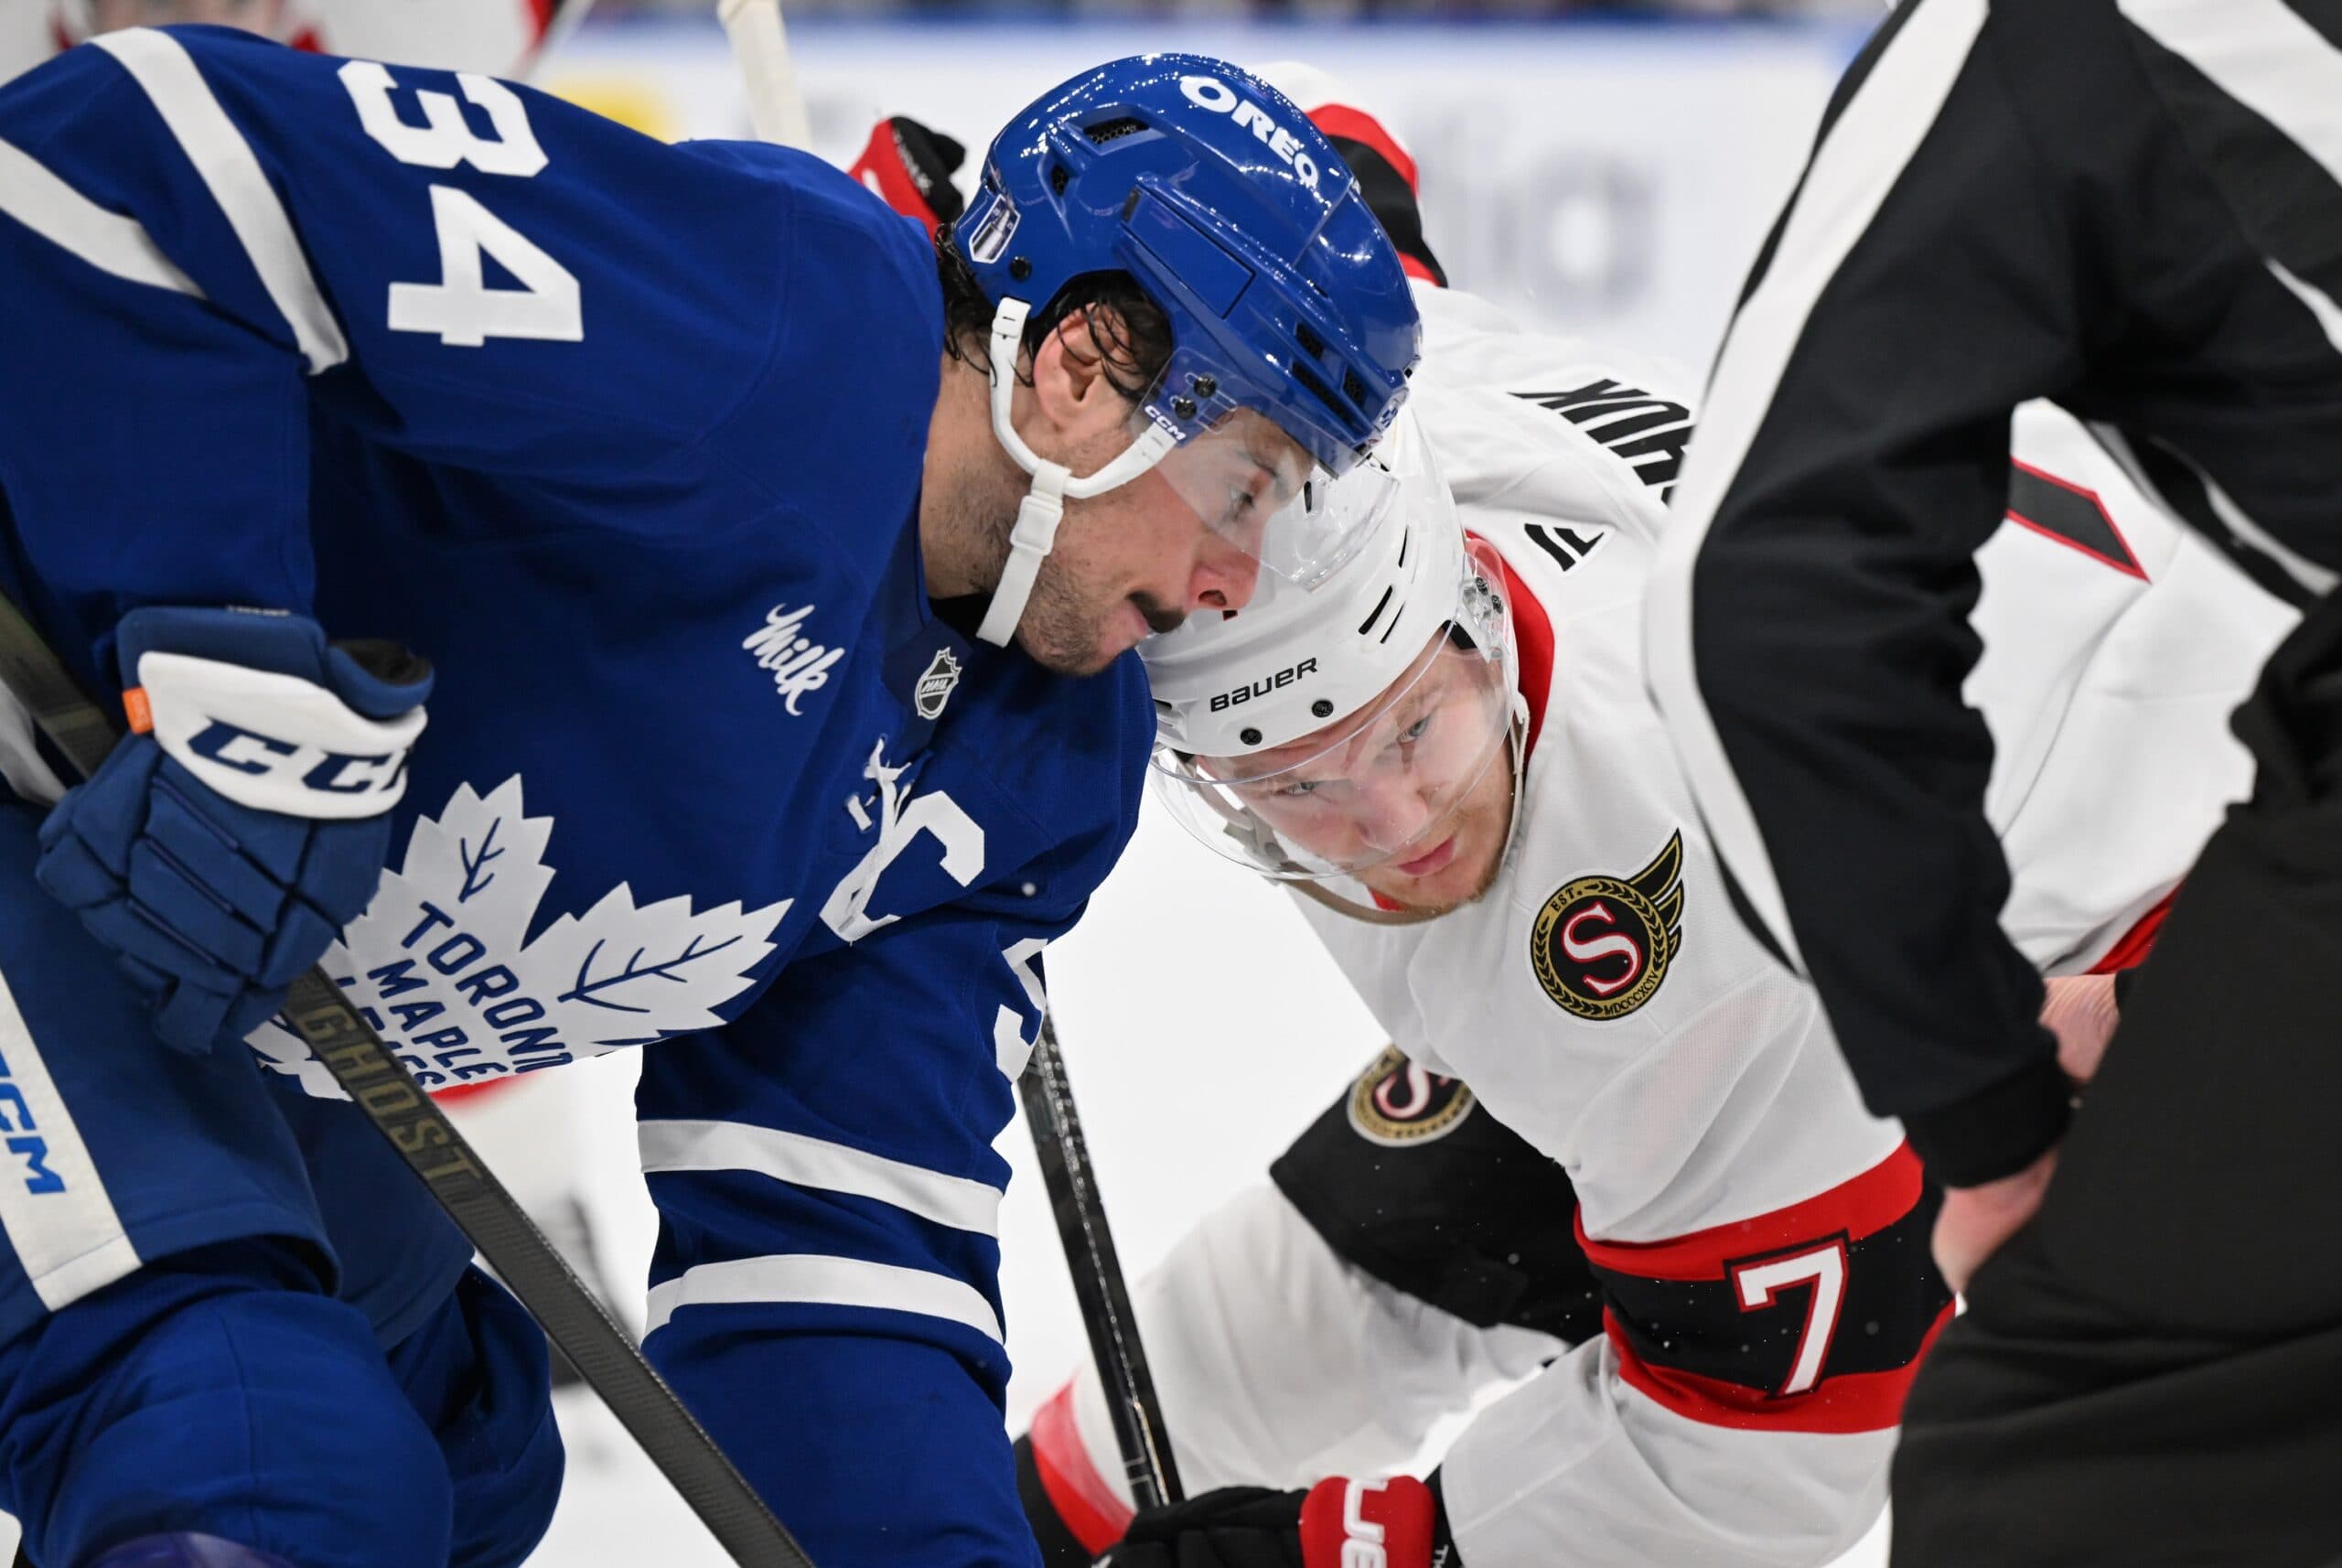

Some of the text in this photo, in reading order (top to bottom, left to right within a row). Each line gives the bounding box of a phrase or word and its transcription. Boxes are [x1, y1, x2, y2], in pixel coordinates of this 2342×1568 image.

[1179, 75, 1319, 188] OREO
[338, 59, 584, 348] 34
[1144, 404, 1187, 440] CCM
[742, 603, 845, 716] Milk
[1549, 886, 1583, 913] EST.
[1561, 899, 1642, 997] S
[367, 959, 510, 1079] MAPLE
[0, 1047, 67, 1195] CM
[297, 1005, 483, 1181] GHOST
[1730, 1237, 1850, 1397] 7
